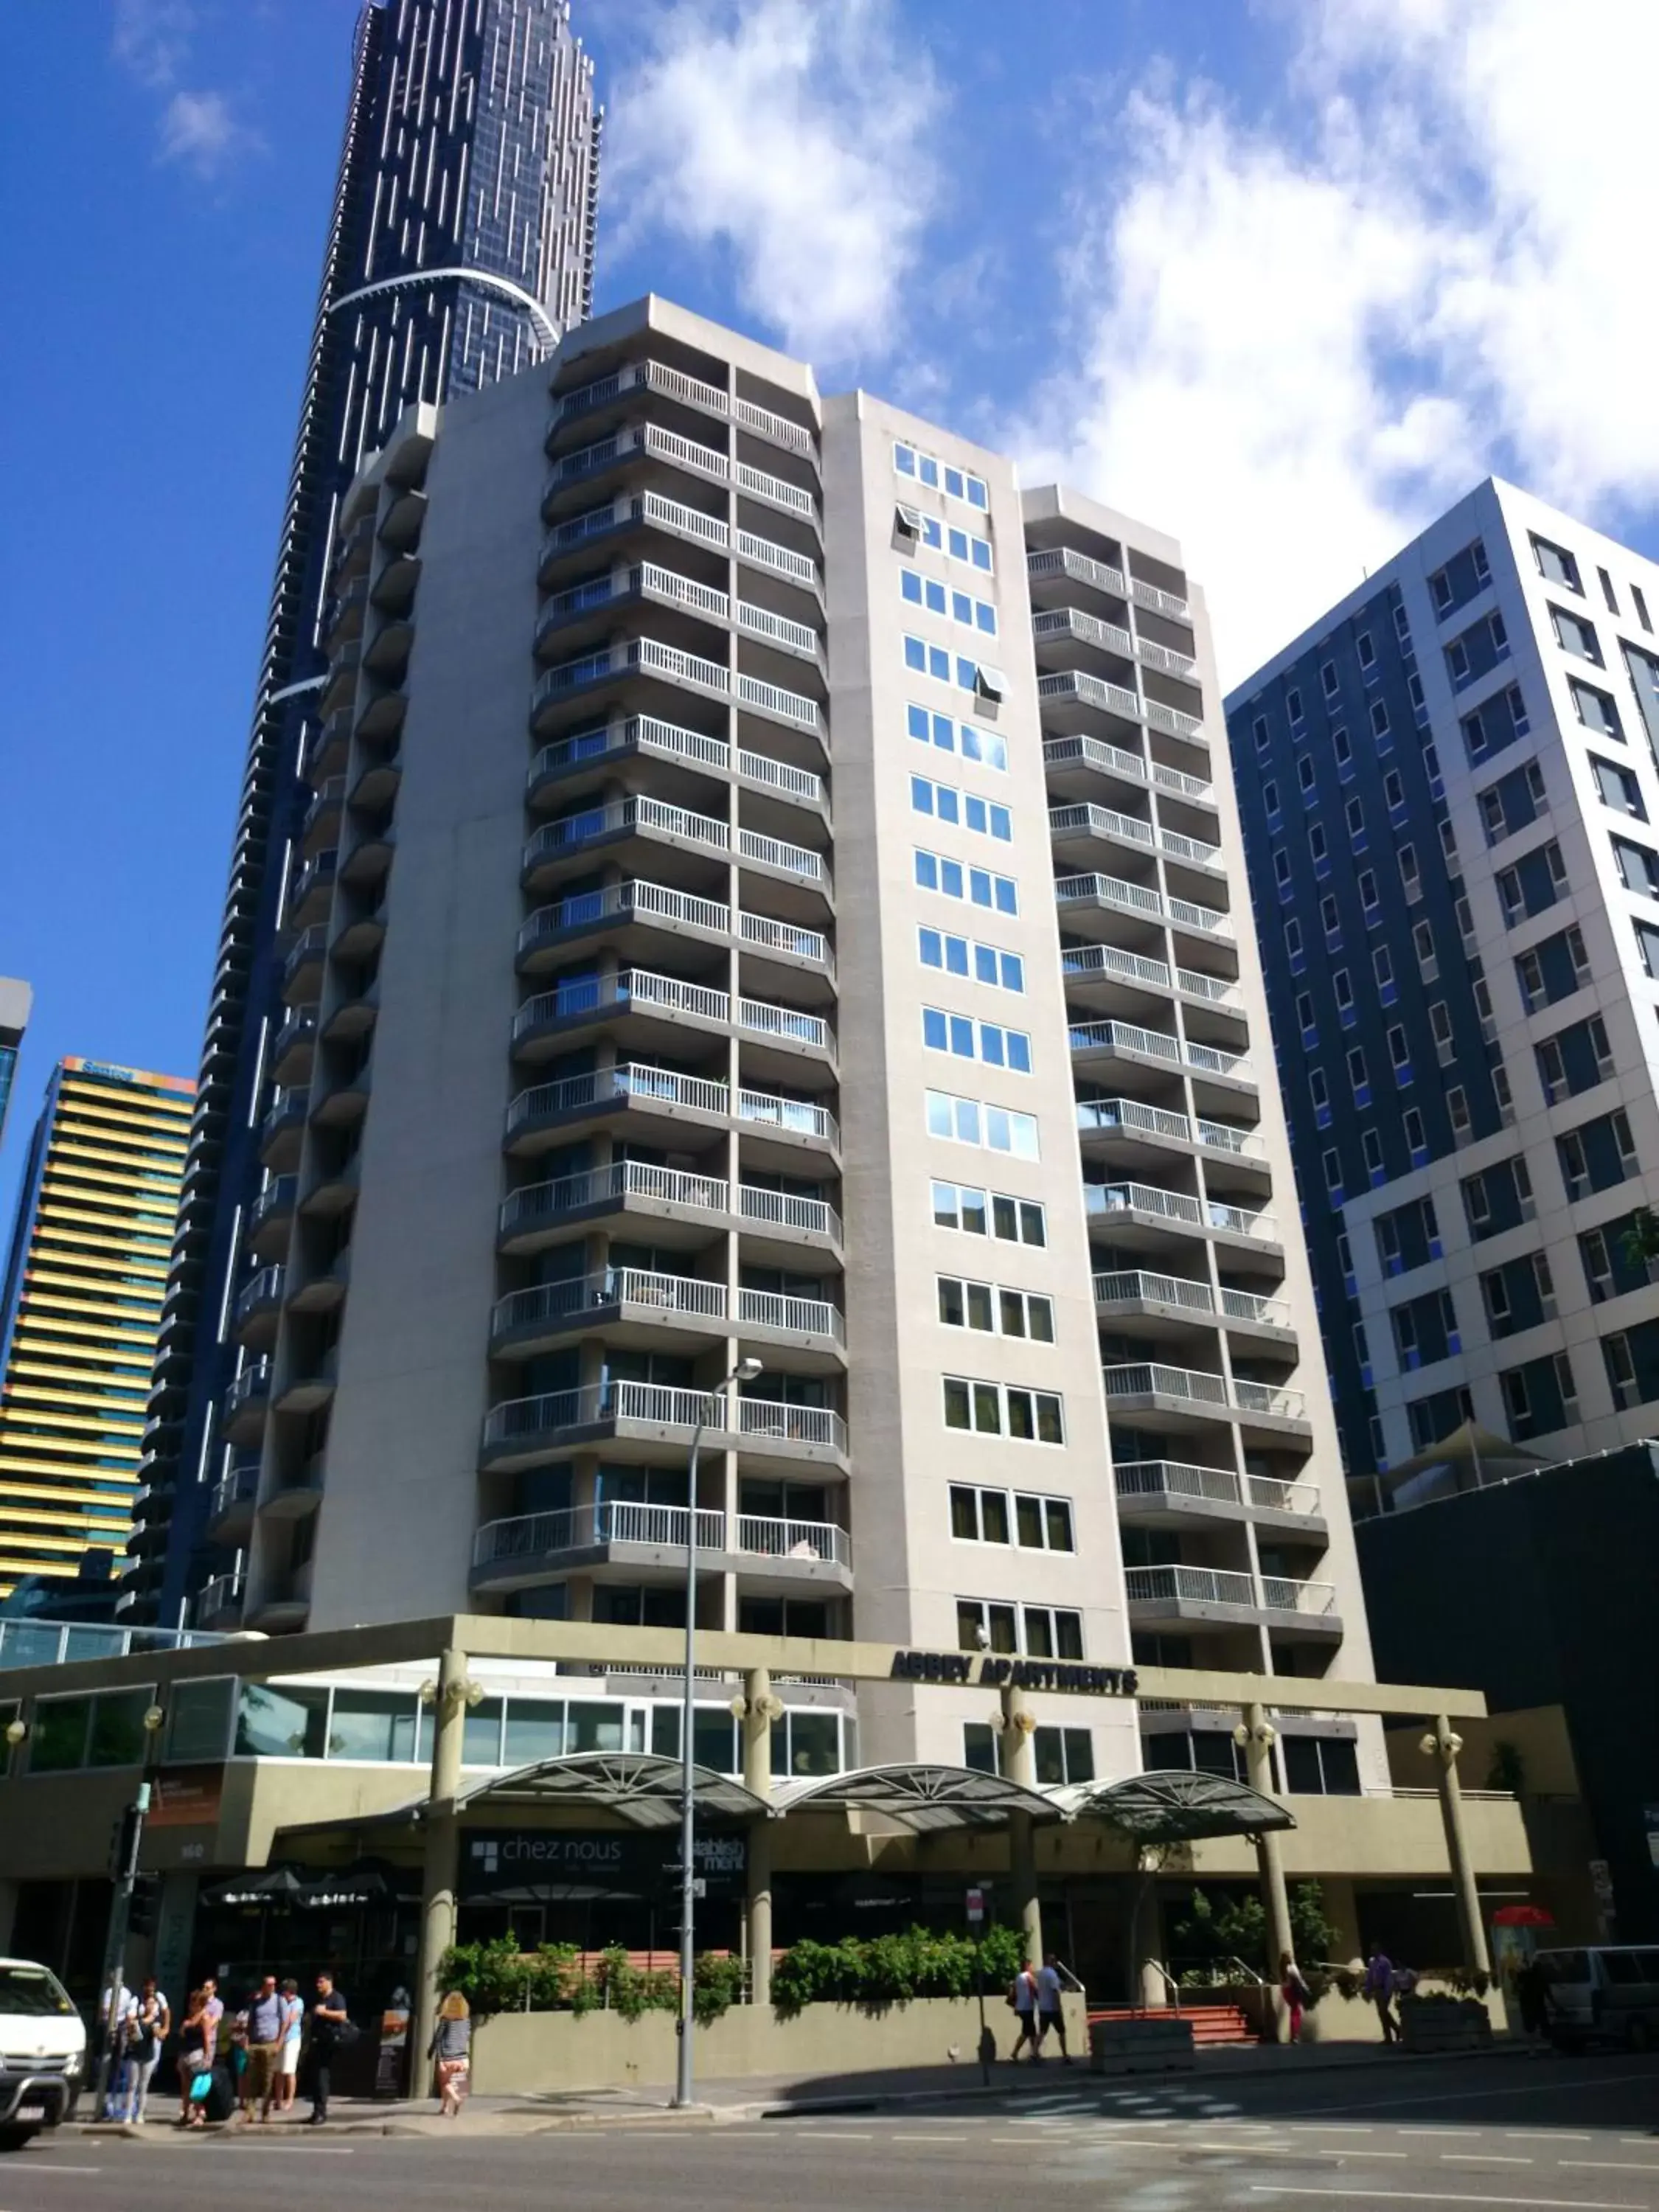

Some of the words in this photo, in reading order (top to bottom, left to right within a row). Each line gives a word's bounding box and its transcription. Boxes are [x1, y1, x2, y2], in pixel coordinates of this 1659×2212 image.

[891, 1650, 973, 1682] ABBEY
[979, 1657, 1138, 1695] APARTMENTS
[503, 1835, 560, 1860] chez
[565, 1840, 622, 1860] nous
